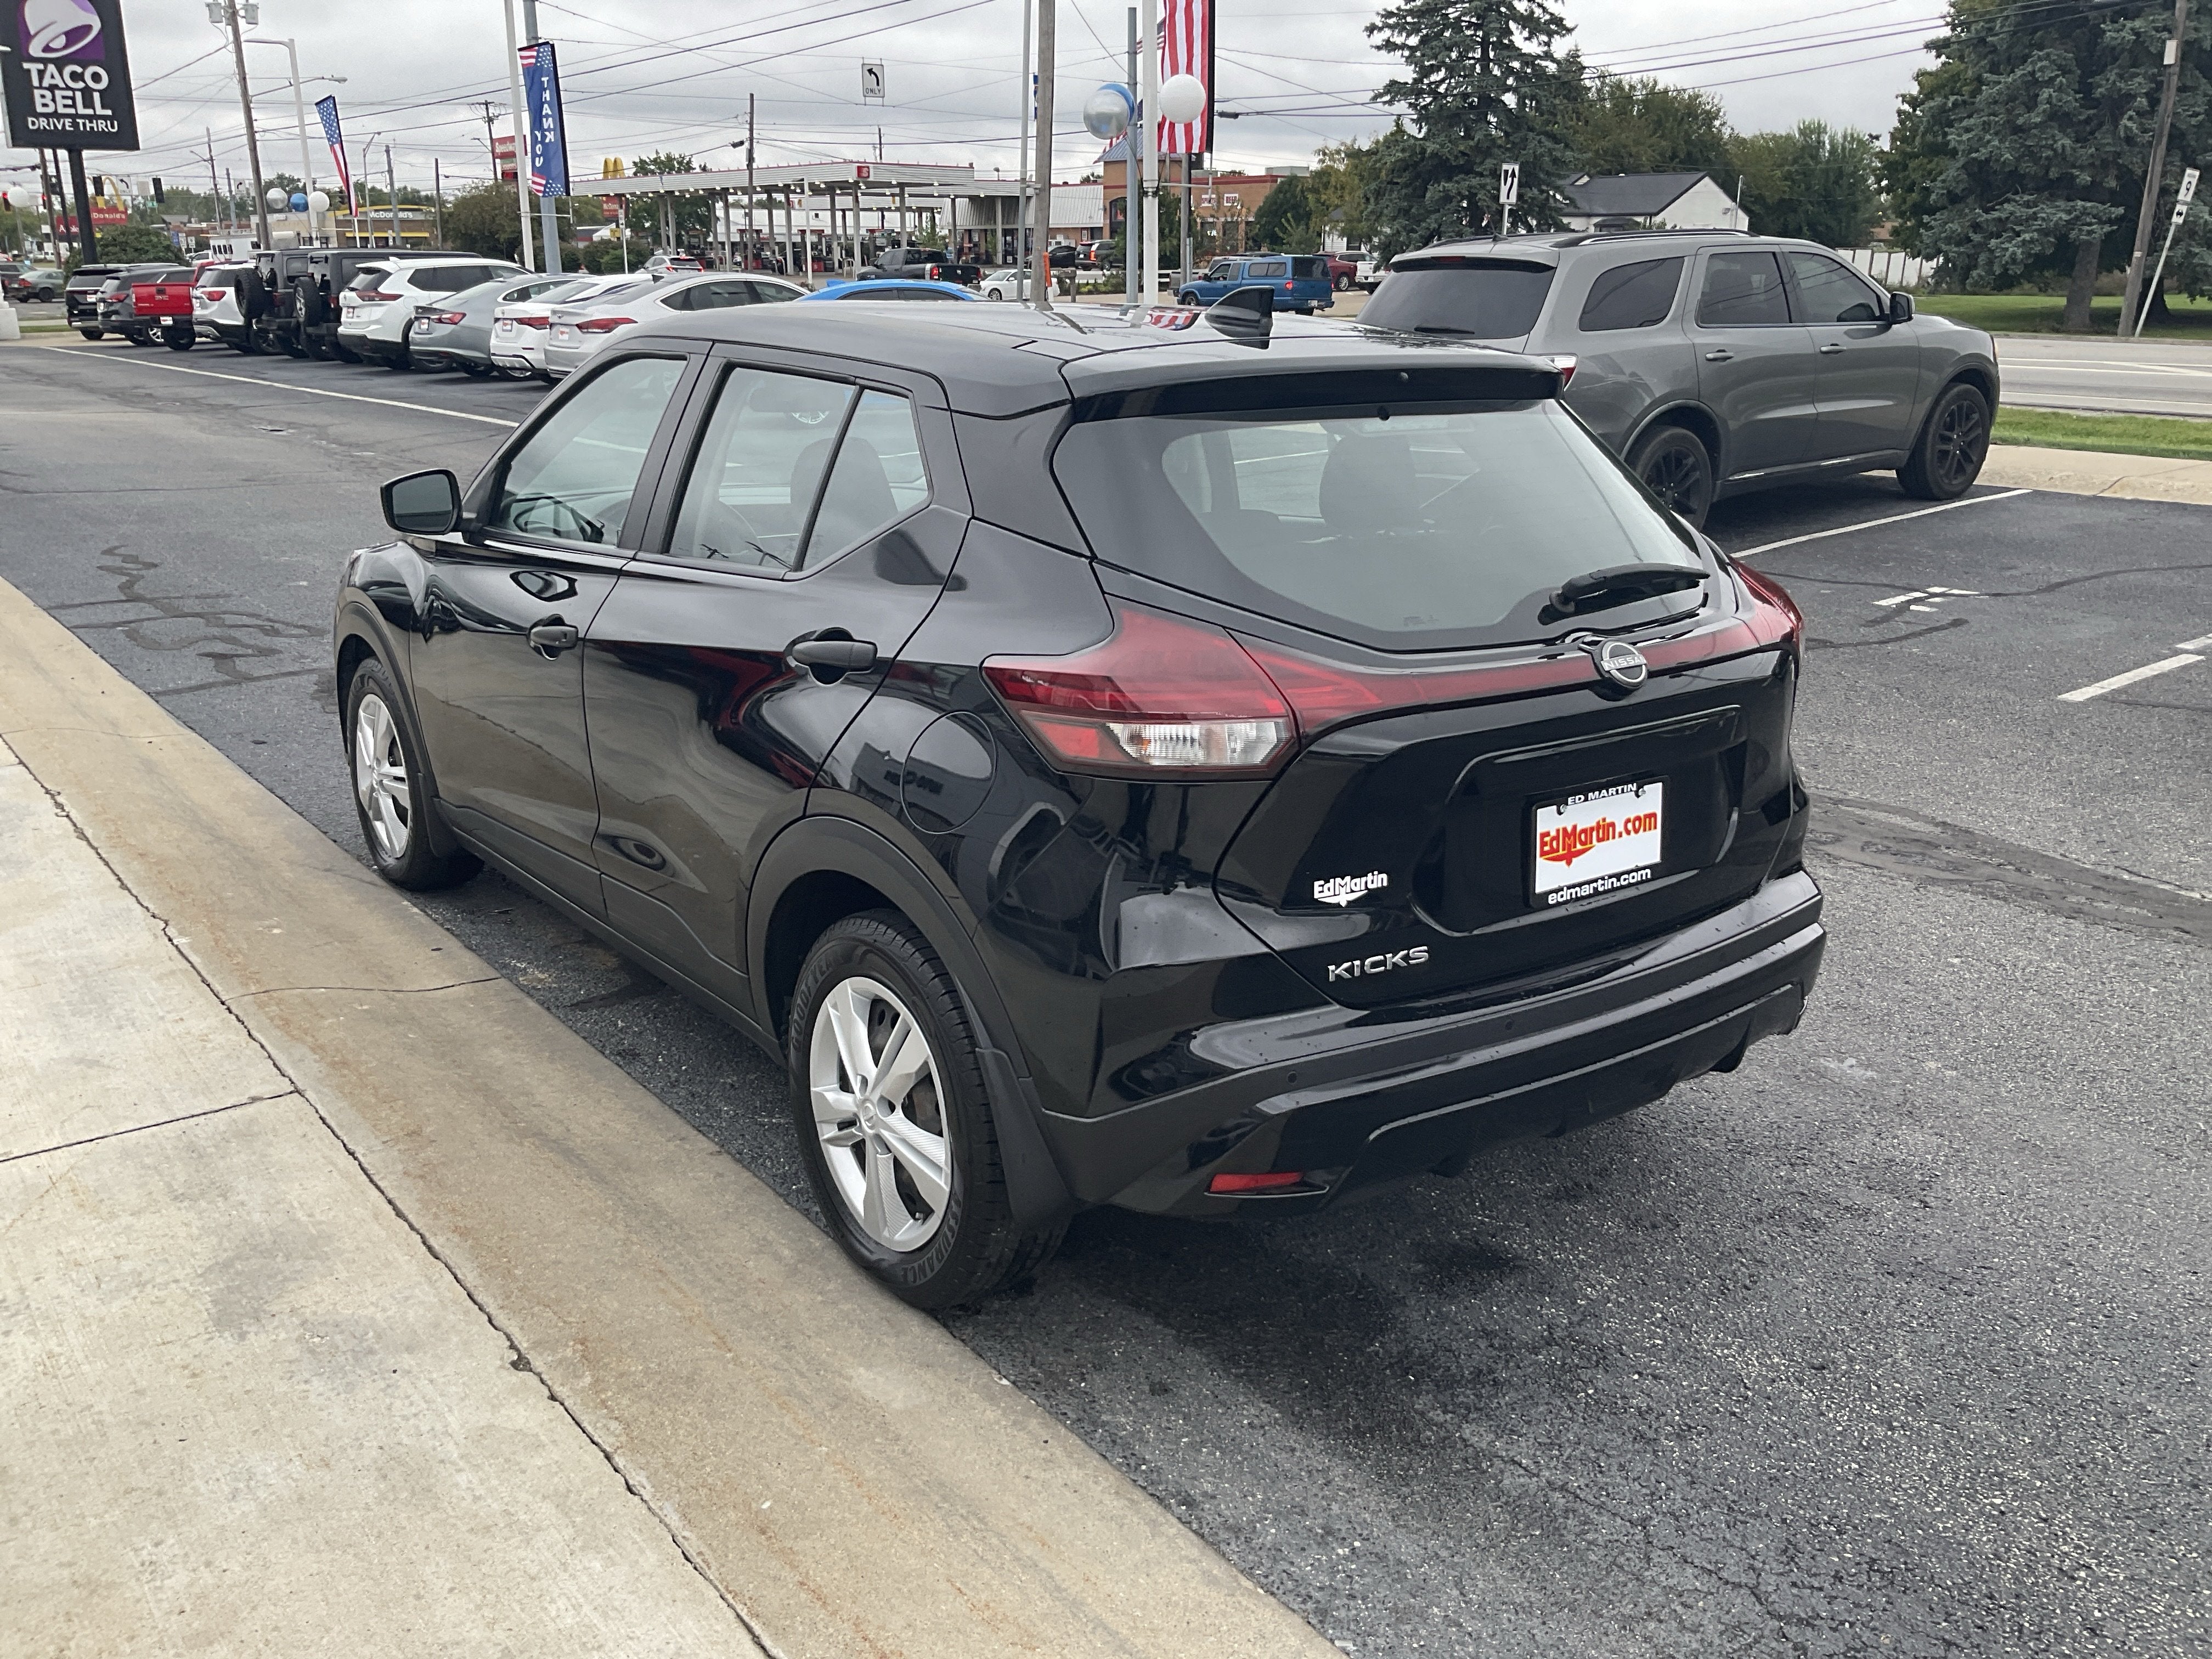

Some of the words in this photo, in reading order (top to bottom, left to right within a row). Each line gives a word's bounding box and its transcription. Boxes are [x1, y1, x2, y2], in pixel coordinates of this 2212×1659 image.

[22, 62, 109, 91] TACO
[33, 89, 112, 115] BELL
[27, 117, 74, 131] DRIVE
[76, 119, 119, 132] THRU
[1568, 794, 1585, 805] ED
[1588, 783, 1637, 801] MARTIN
[1539, 811, 1657, 861] EdMartin.com
[1314, 871, 1388, 900] EdMartin
[1548, 868, 1651, 905] edmartin.com
[1328, 946, 1429, 981] KICKS
[791, 956, 832, 1052] GOODYEA
